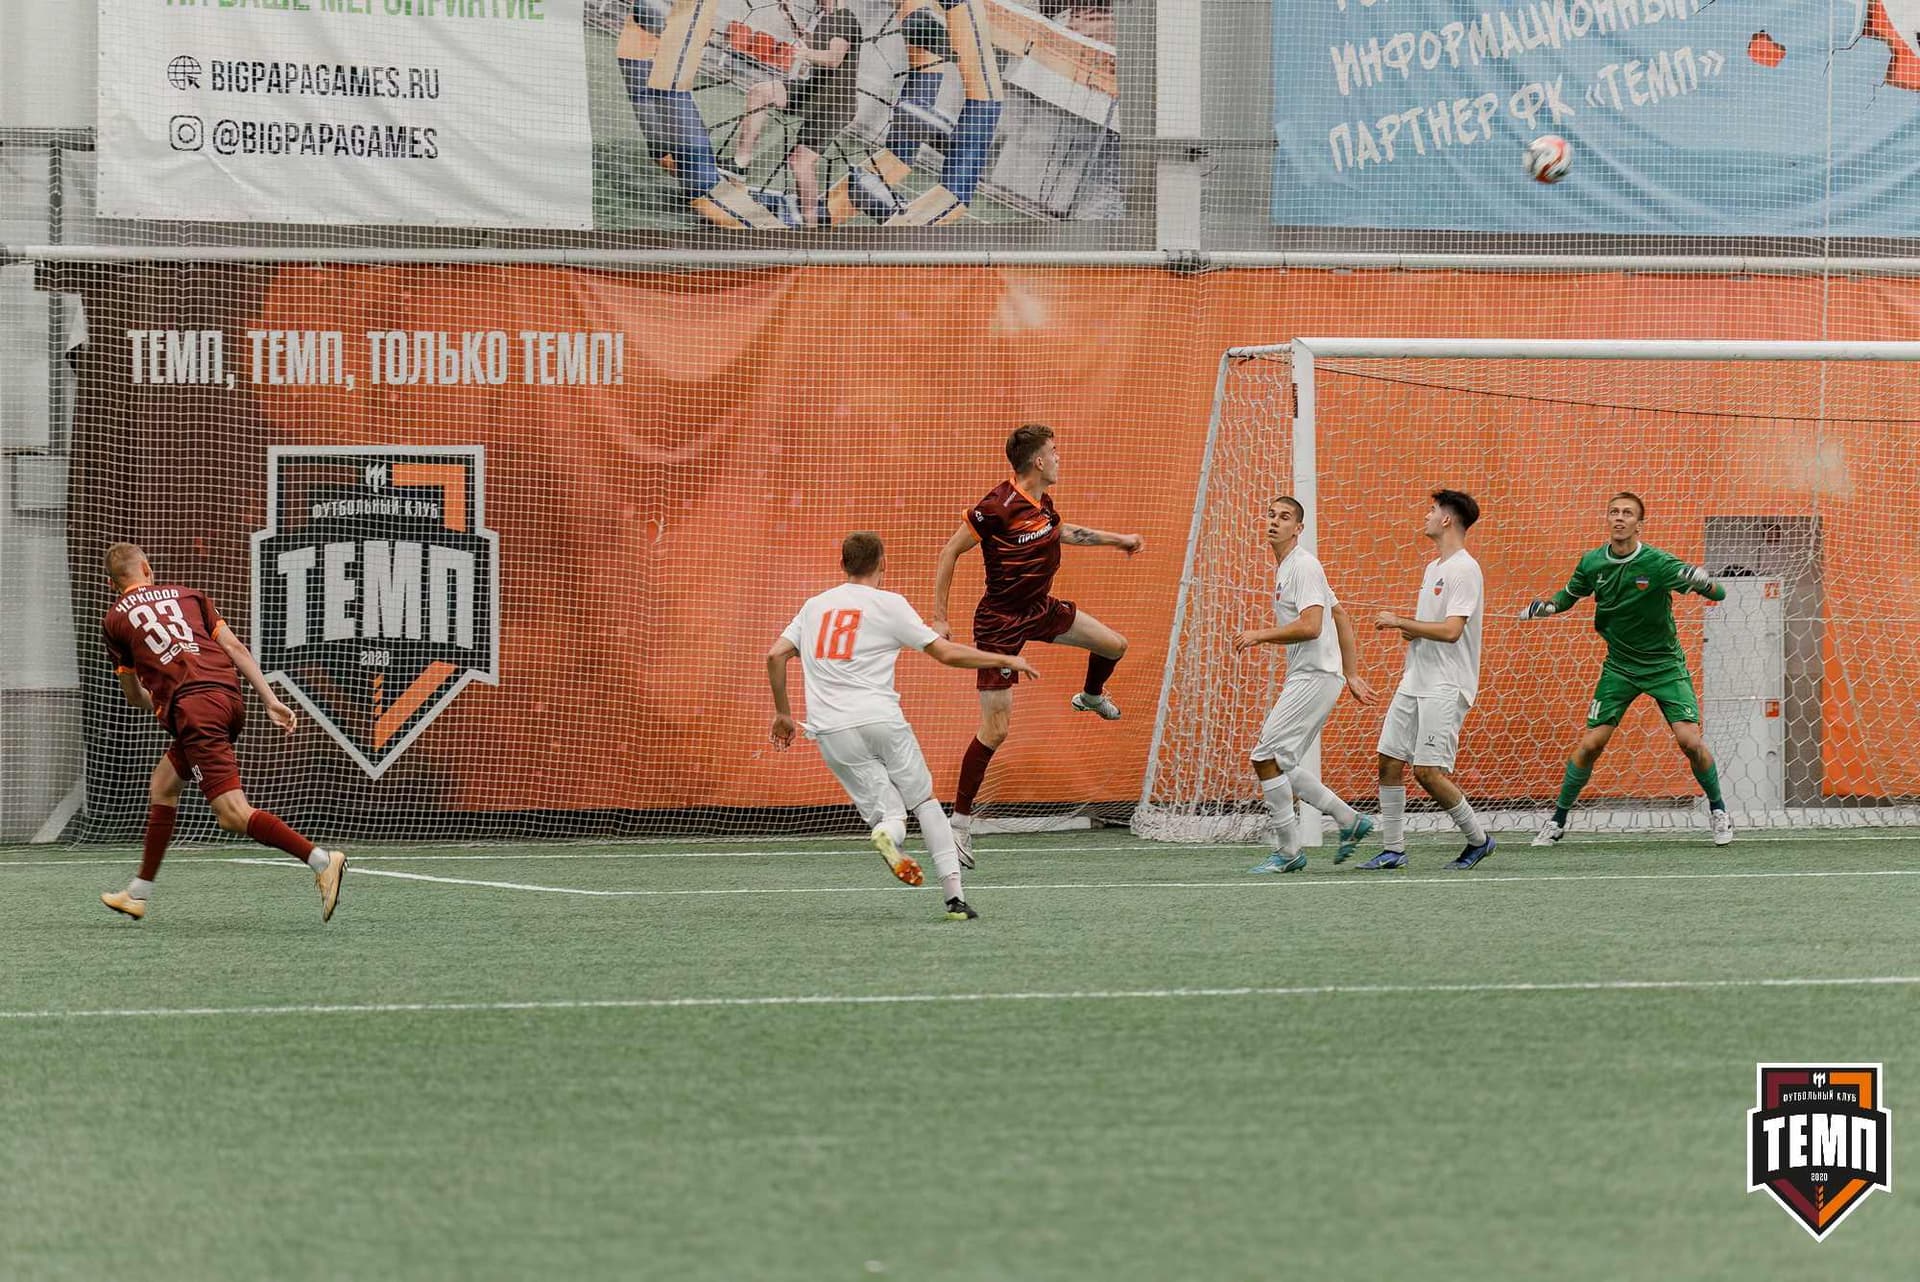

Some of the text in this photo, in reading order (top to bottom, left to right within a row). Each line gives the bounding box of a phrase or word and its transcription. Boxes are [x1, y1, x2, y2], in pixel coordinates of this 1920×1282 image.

[211, 60, 439, 99] BIGPAPAGAMES.RU
[1329, 46, 1726, 172] ПАРТНЕР ФК «ТЕМП»
[213, 119, 438, 159] @BIGPAPAGAMES
[127, 330, 624, 390] ТЕМП, ТЕМП, ТОЛЬКО ТЕМП!
[312, 498, 438, 519] ФУТБОЛЬНЫЙ КЛУБ
[277, 540, 474, 650] ТЕМП
[128, 599, 194, 655] 33
[815, 608, 864, 660] 18
